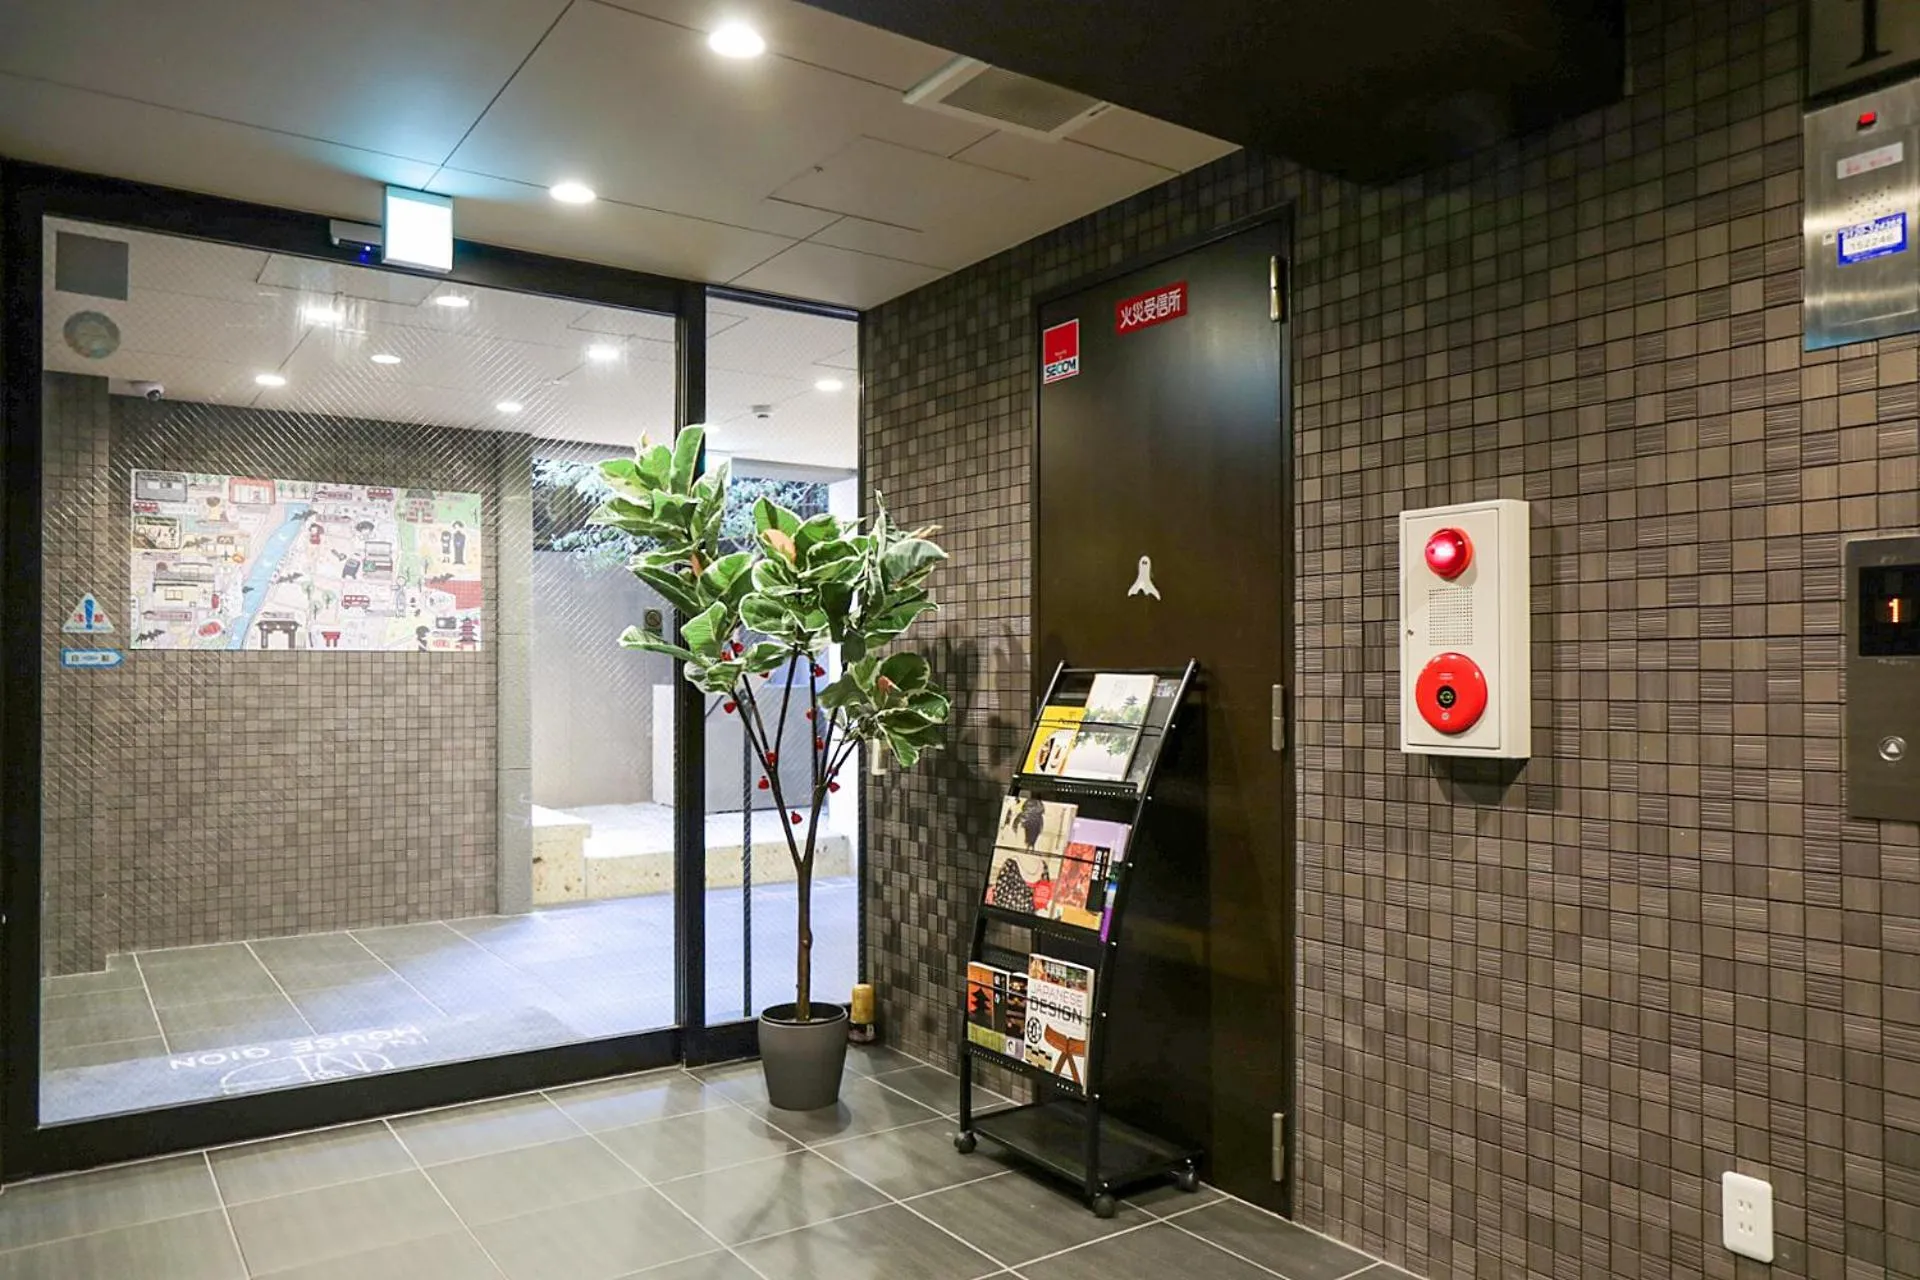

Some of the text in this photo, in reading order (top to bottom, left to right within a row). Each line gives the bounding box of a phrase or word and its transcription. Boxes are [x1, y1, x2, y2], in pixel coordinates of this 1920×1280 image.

[1120, 289, 1181, 329] 火災受信所
[1046, 358, 1076, 377] SECOM
[1888, 598, 1899, 623] 1
[1030, 995, 1082, 1024] DESIGN
[292, 1026, 418, 1053] HOUSE
